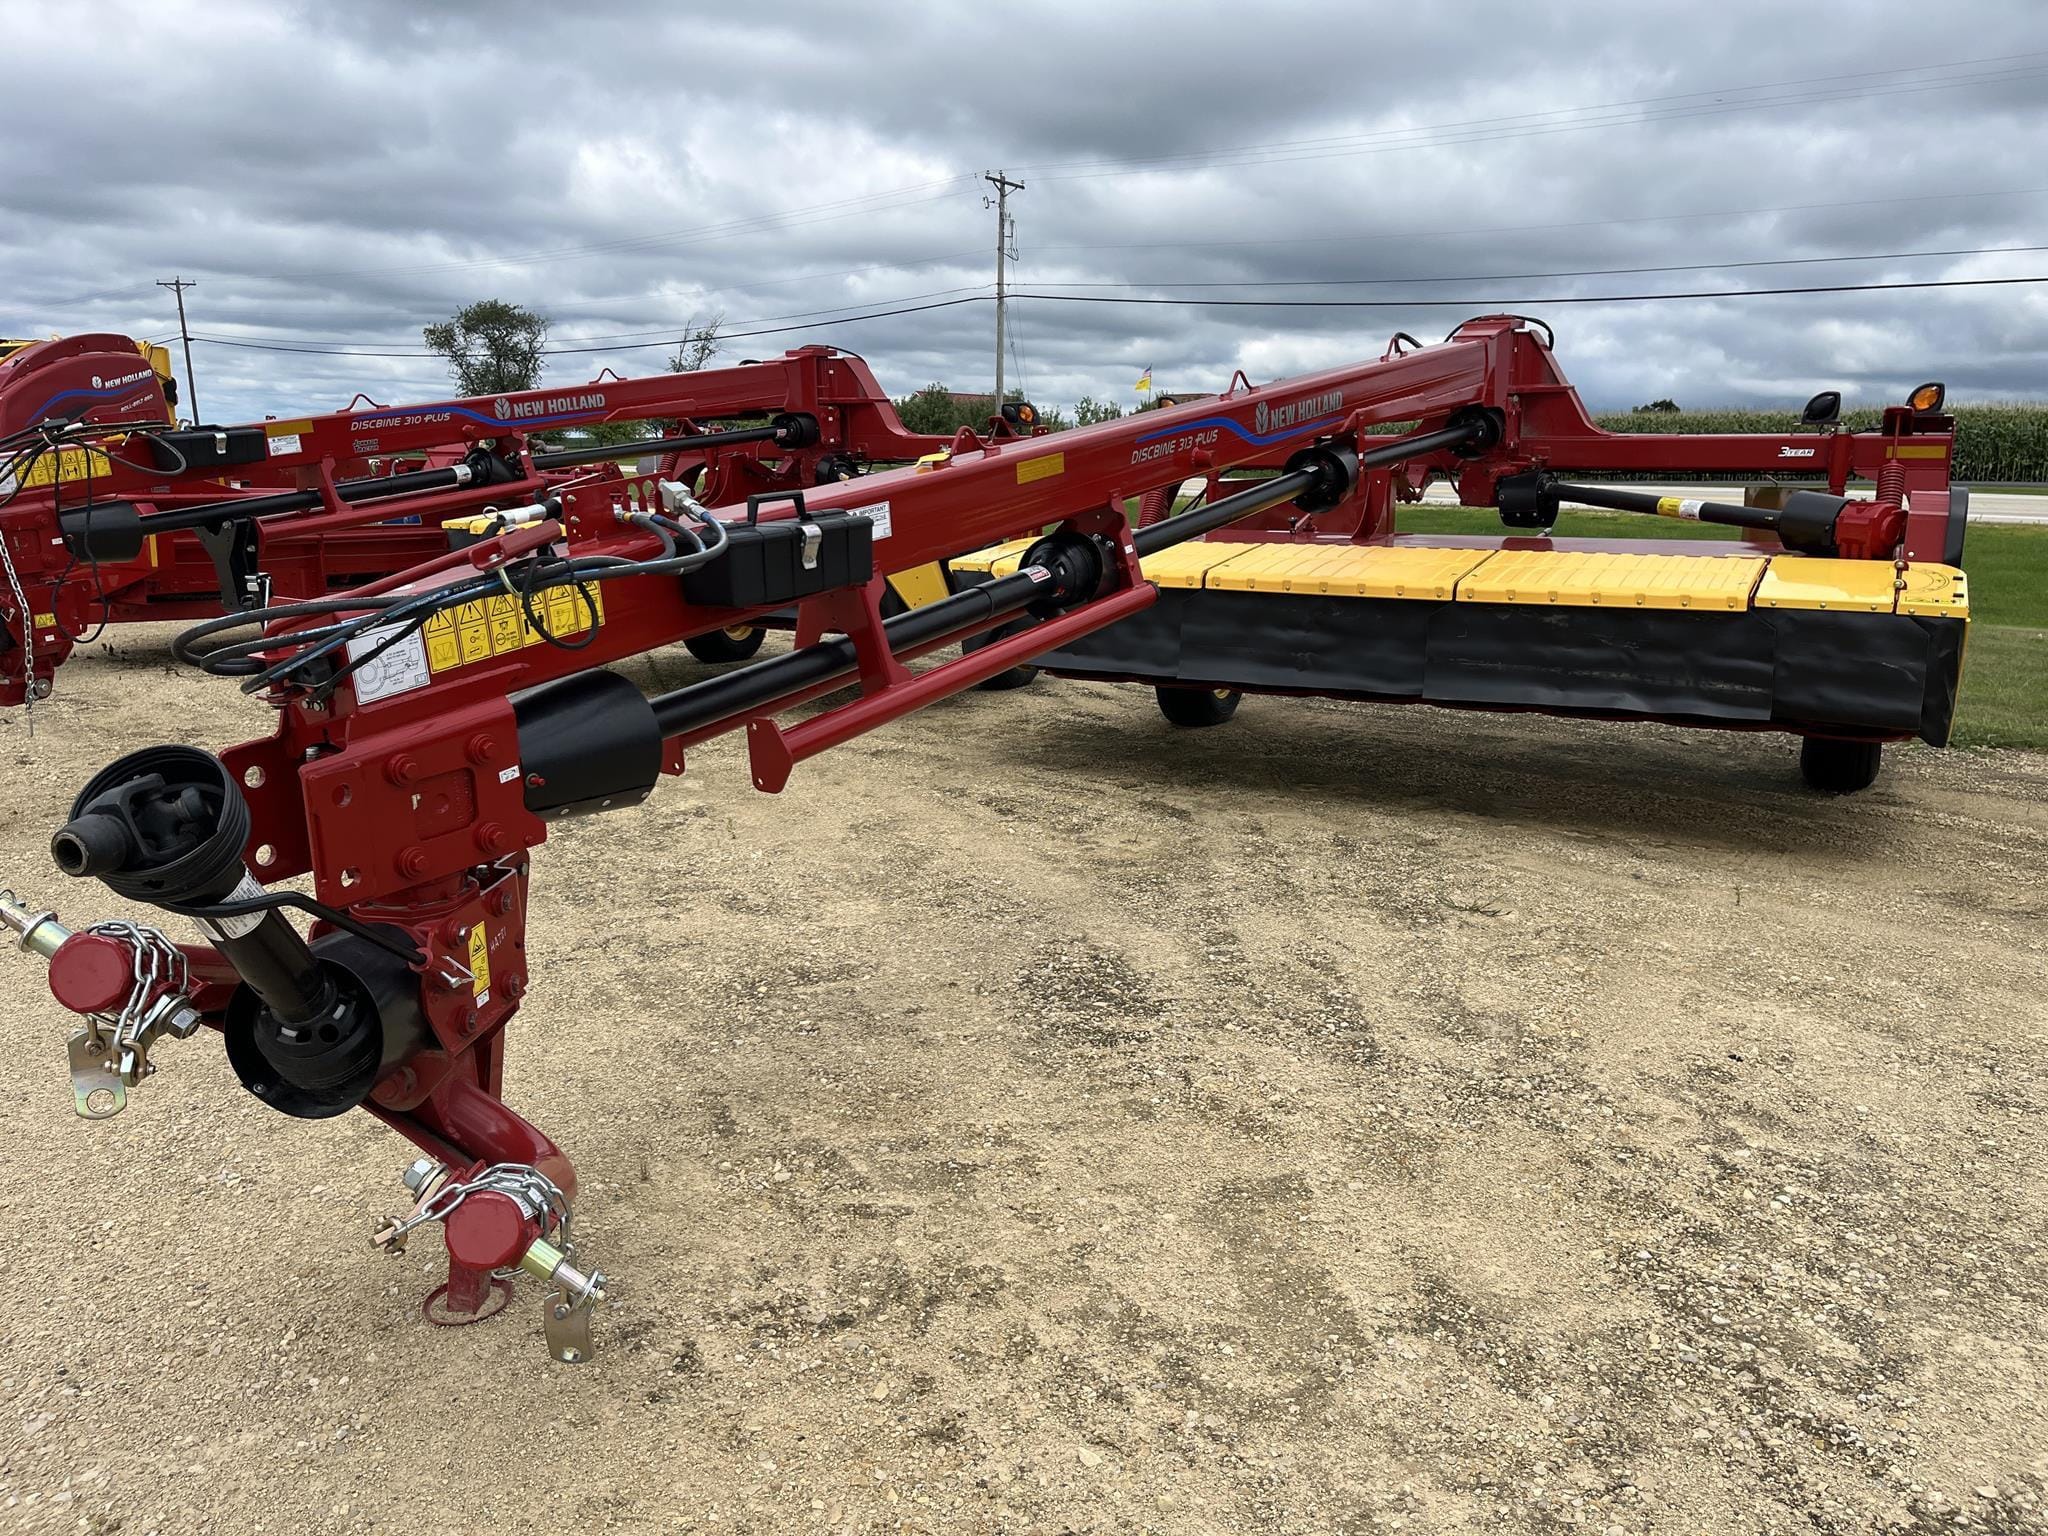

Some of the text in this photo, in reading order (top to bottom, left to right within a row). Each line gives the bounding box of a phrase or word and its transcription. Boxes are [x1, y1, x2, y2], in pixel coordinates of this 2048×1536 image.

[104, 369, 152, 389] NEW HOLLAND
[513, 394, 605, 418] NEW HOLLAND
[1271, 391, 1343, 430] NEW HOLLAND
[350, 418, 401, 431] DISCBINE
[404, 416, 421, 425] 310
[1131, 440, 1177, 464] DISCBINE
[1178, 436, 1193, 451] 313
